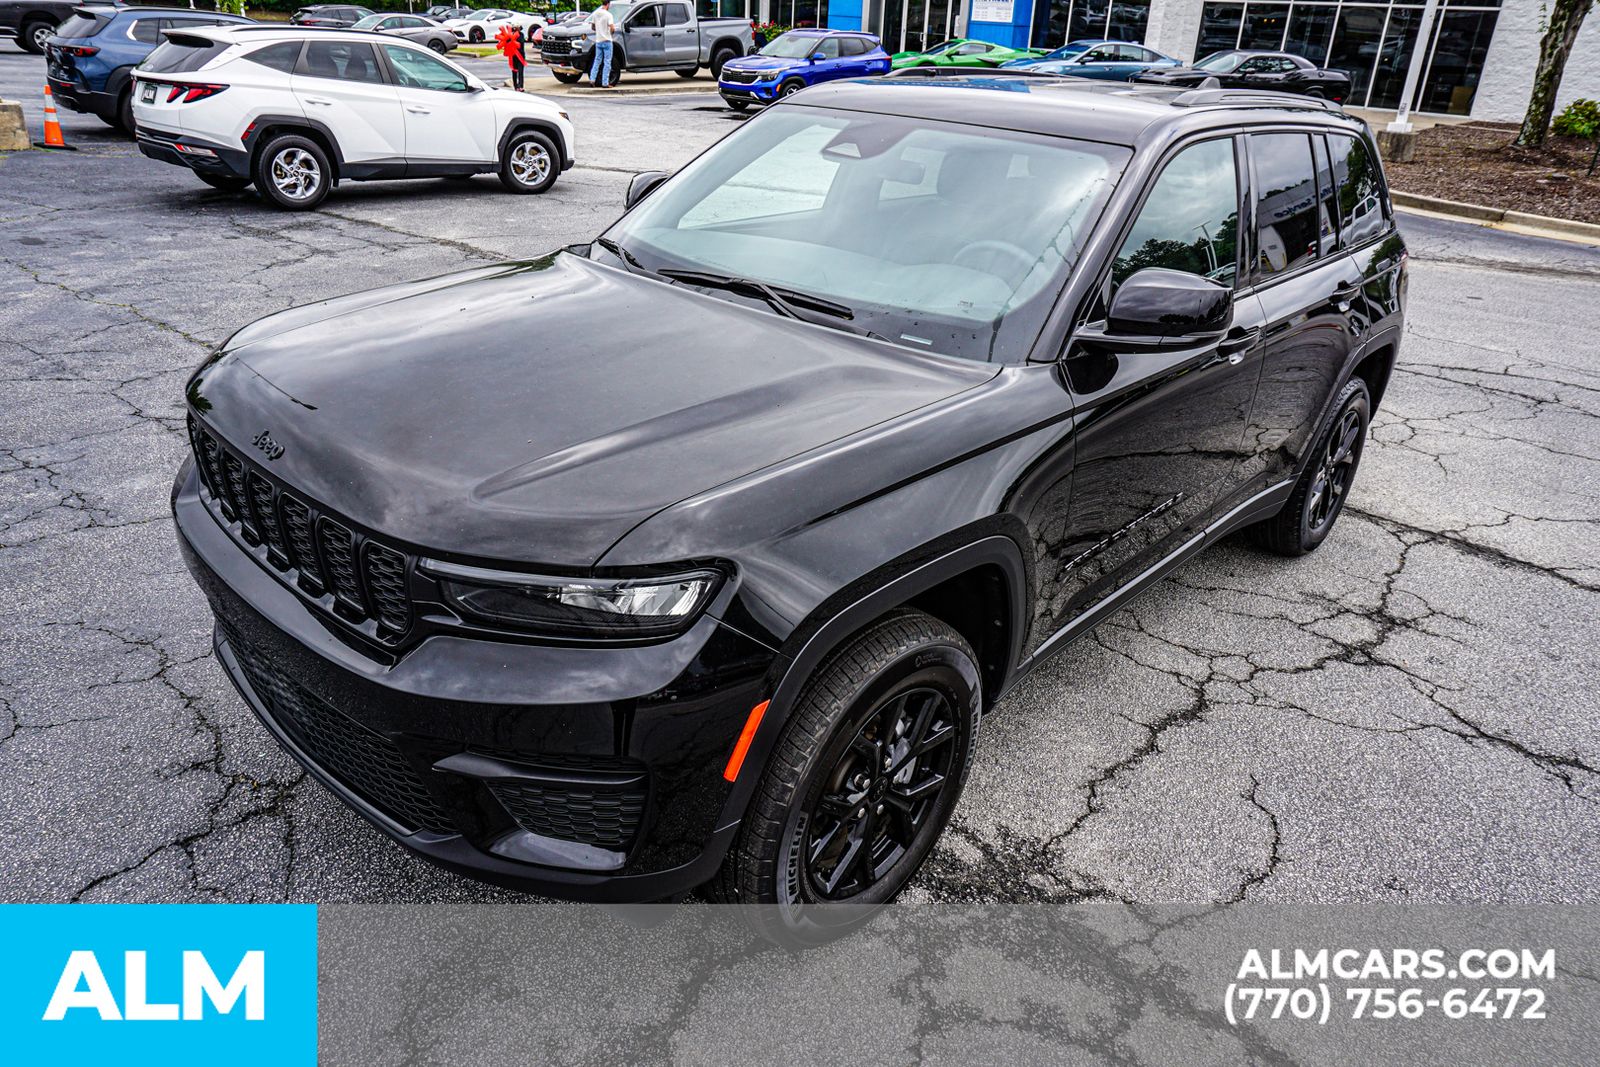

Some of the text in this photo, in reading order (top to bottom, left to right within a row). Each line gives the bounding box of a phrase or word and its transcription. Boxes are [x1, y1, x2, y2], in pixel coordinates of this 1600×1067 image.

[251, 428, 285, 461] Jeep
[960, 712, 979, 782] MICHELIN
[785, 816, 807, 897] MICHELIN
